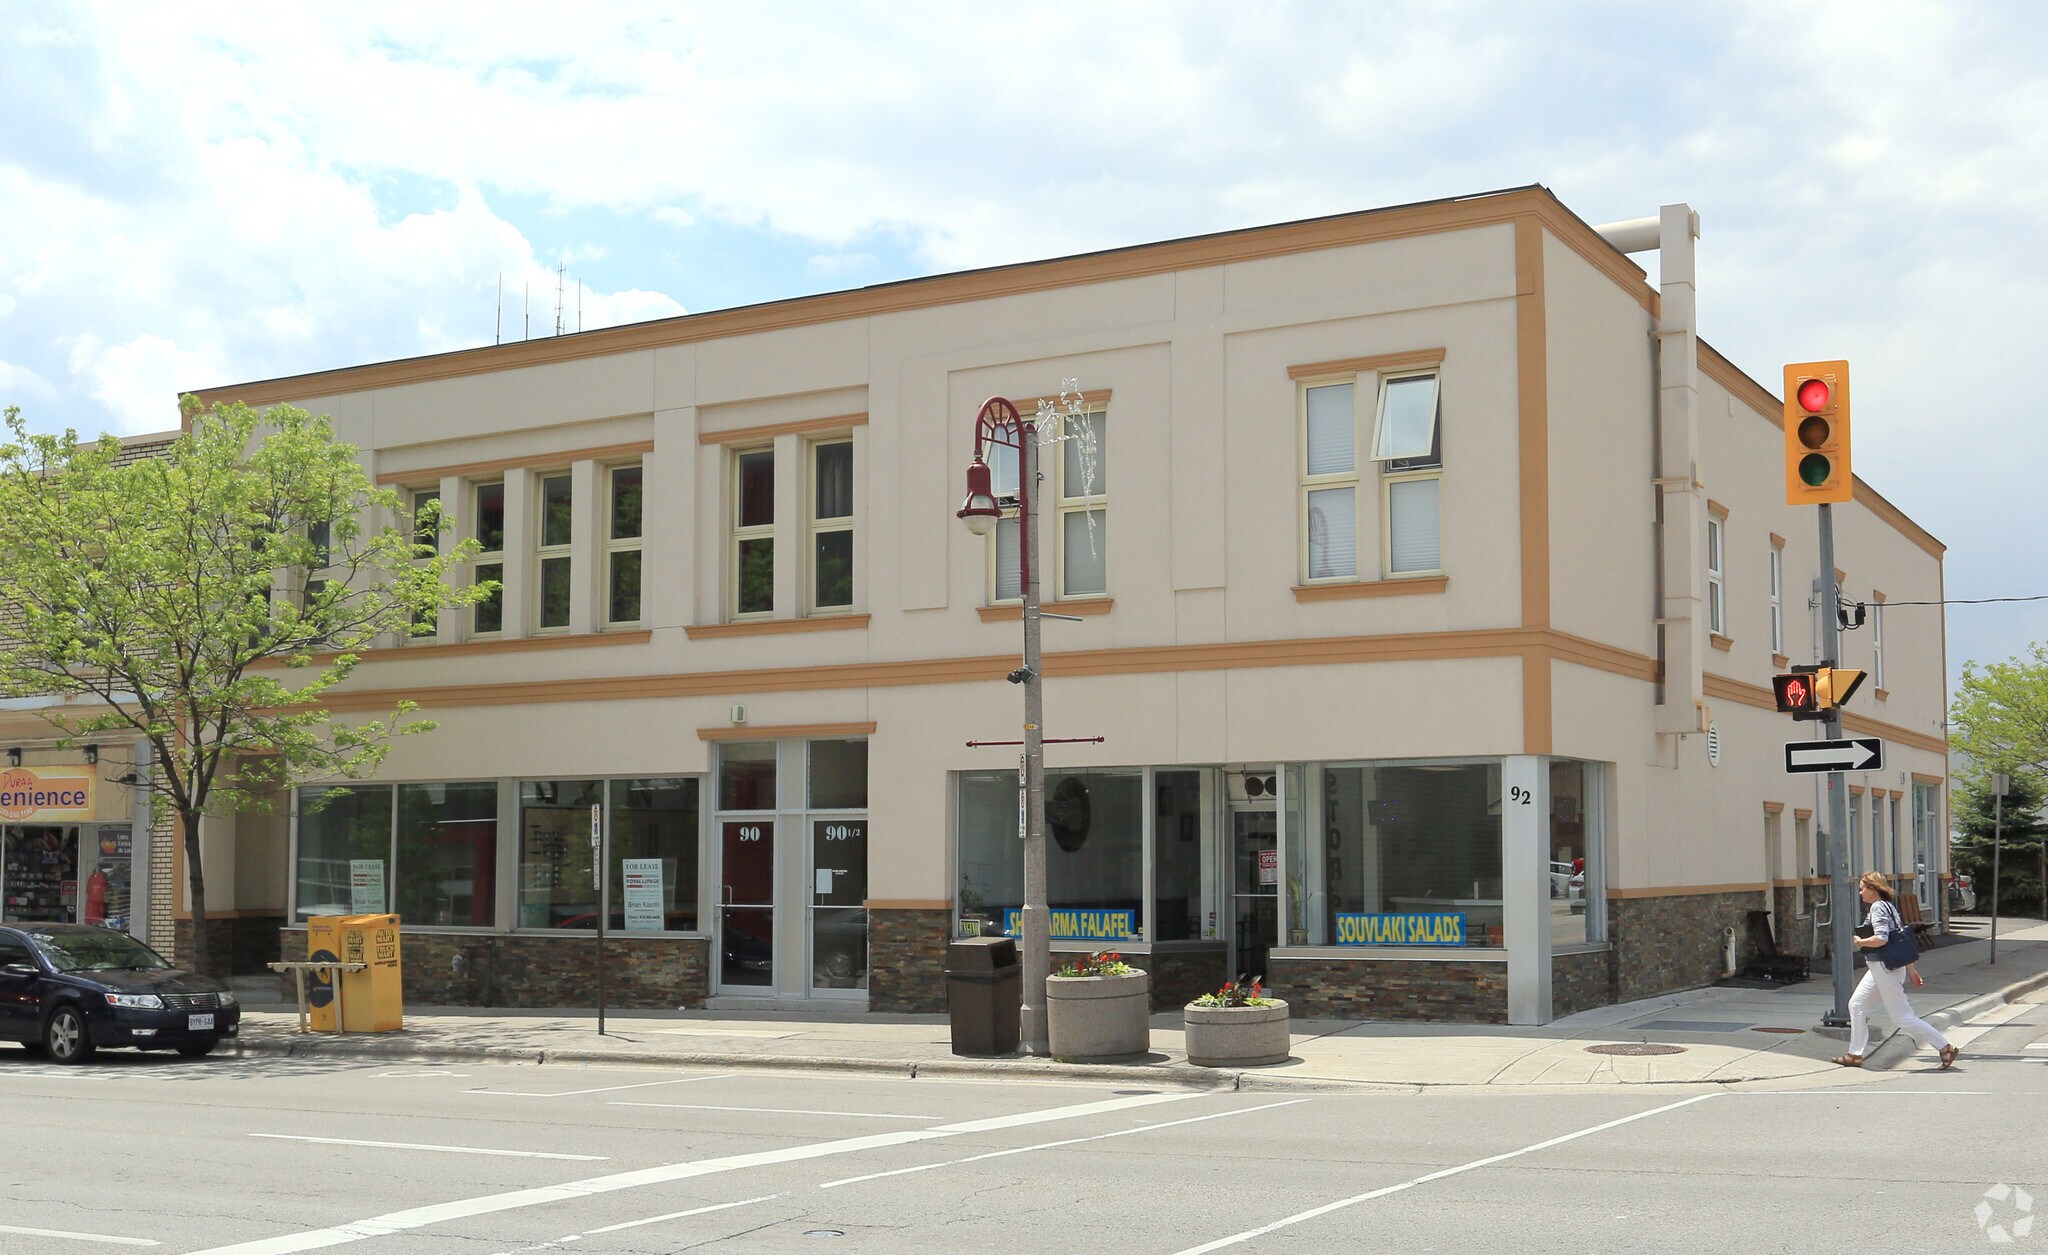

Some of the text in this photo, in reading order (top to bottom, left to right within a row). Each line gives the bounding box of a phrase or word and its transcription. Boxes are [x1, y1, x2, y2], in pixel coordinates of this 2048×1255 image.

[1, 787, 85, 806] enience
[1511, 786, 1531, 805] 92
[740, 827, 760, 841] 90
[826, 826, 847, 840] 90
[1010, 912, 1131, 937] SHRMA FALAFEL
[1338, 915, 1460, 943] SOUVLAKI SALADS
[375, 935, 395, 944] MART
[377, 928, 393, 937] AUTO
[377, 951, 395, 959] MART
